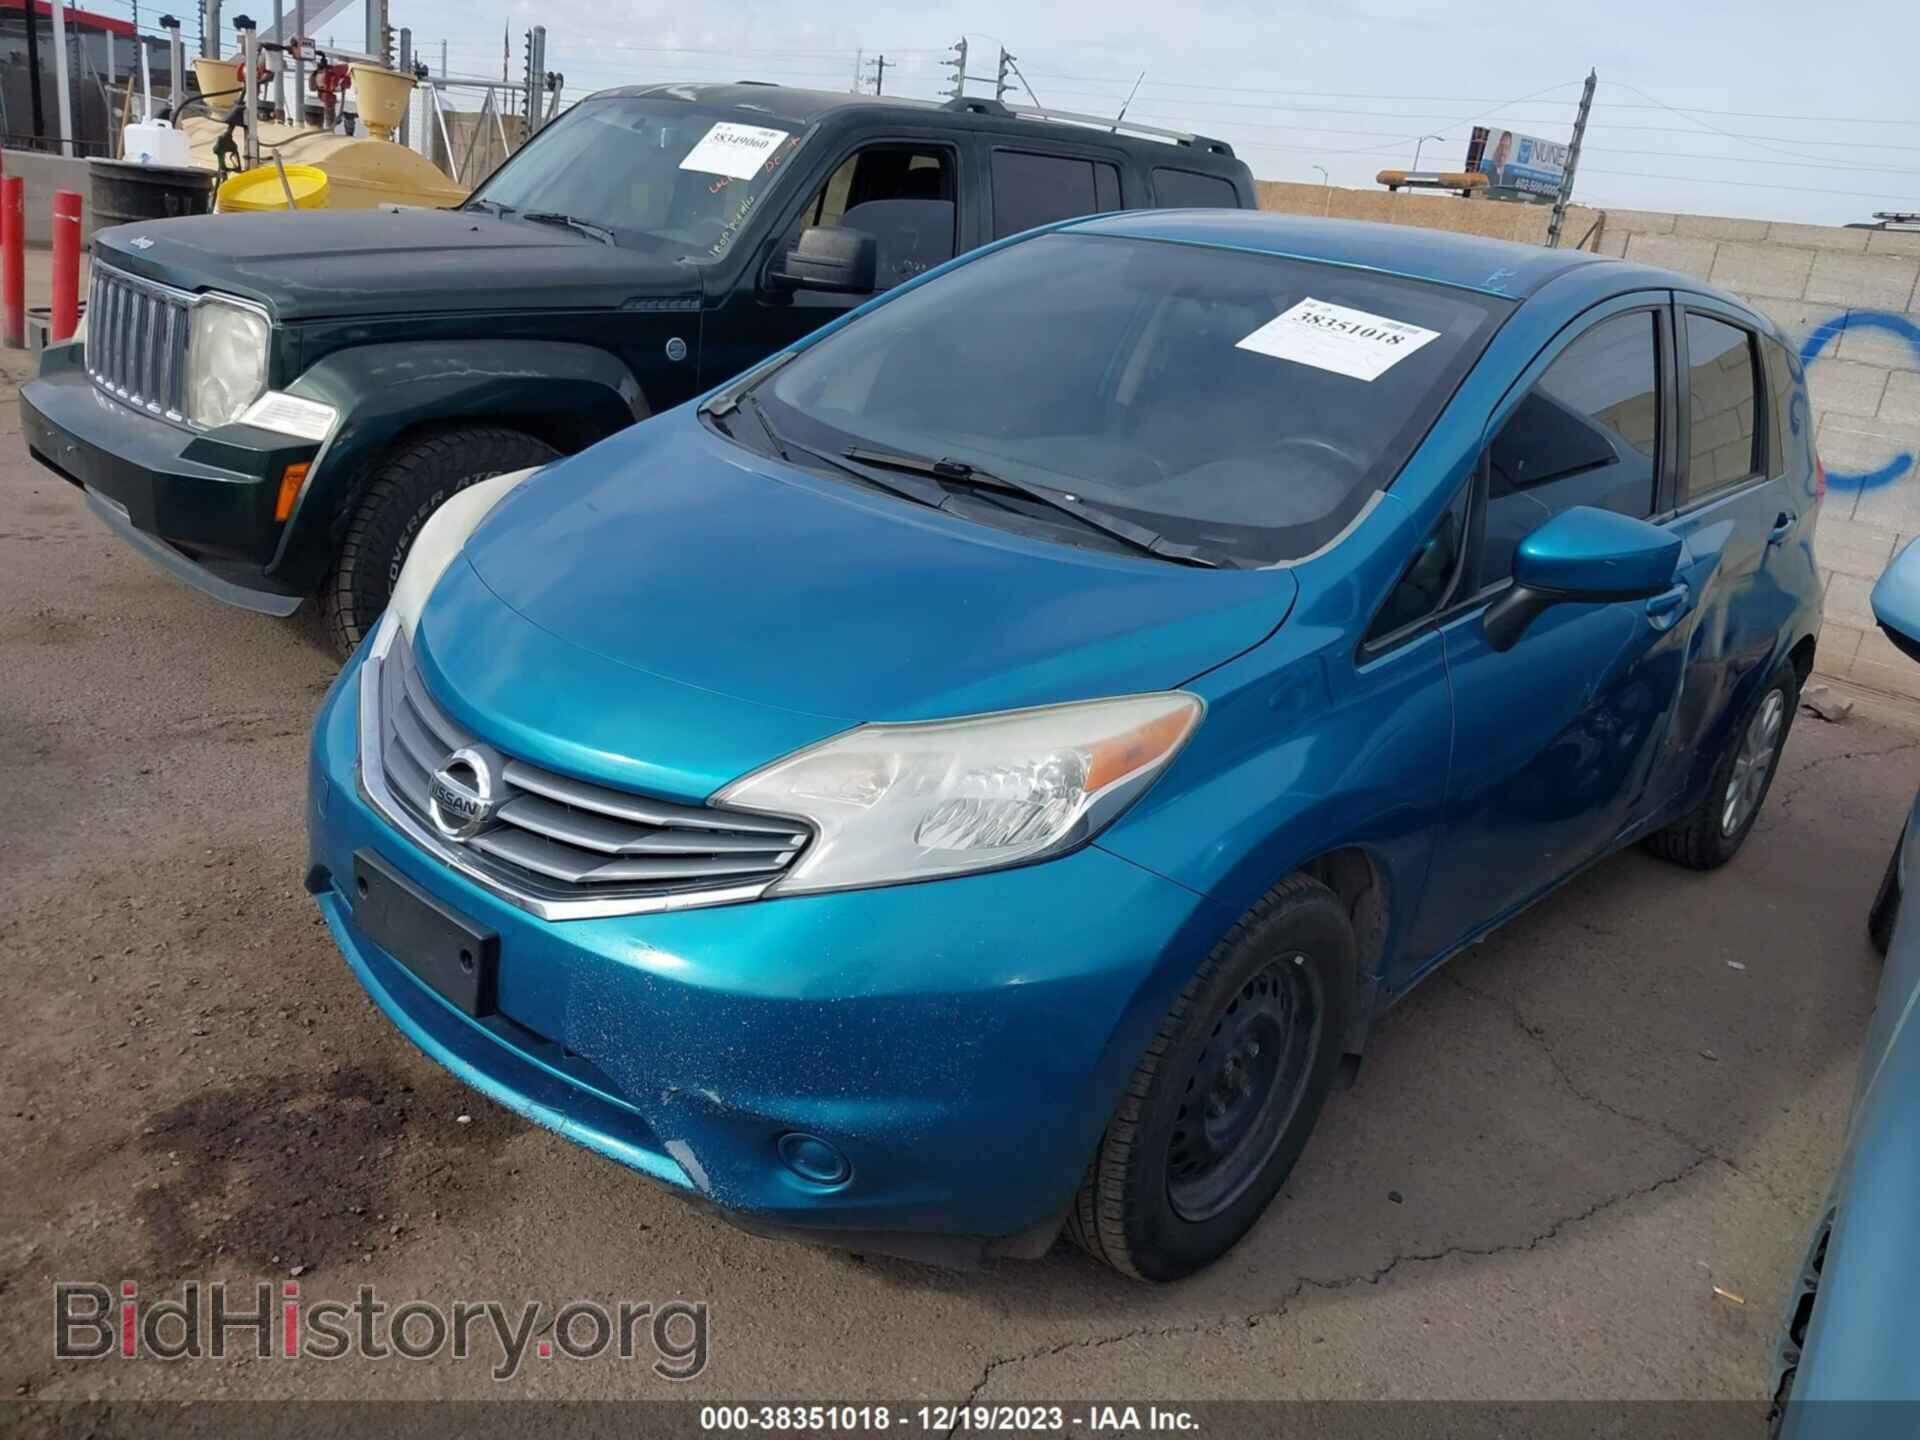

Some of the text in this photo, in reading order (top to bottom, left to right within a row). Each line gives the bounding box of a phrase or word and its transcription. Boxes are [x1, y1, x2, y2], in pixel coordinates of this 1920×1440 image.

[713, 132, 769, 149] 38349060
[1295, 311, 1405, 345] 38351018
[431, 782, 479, 816] NISSAN
